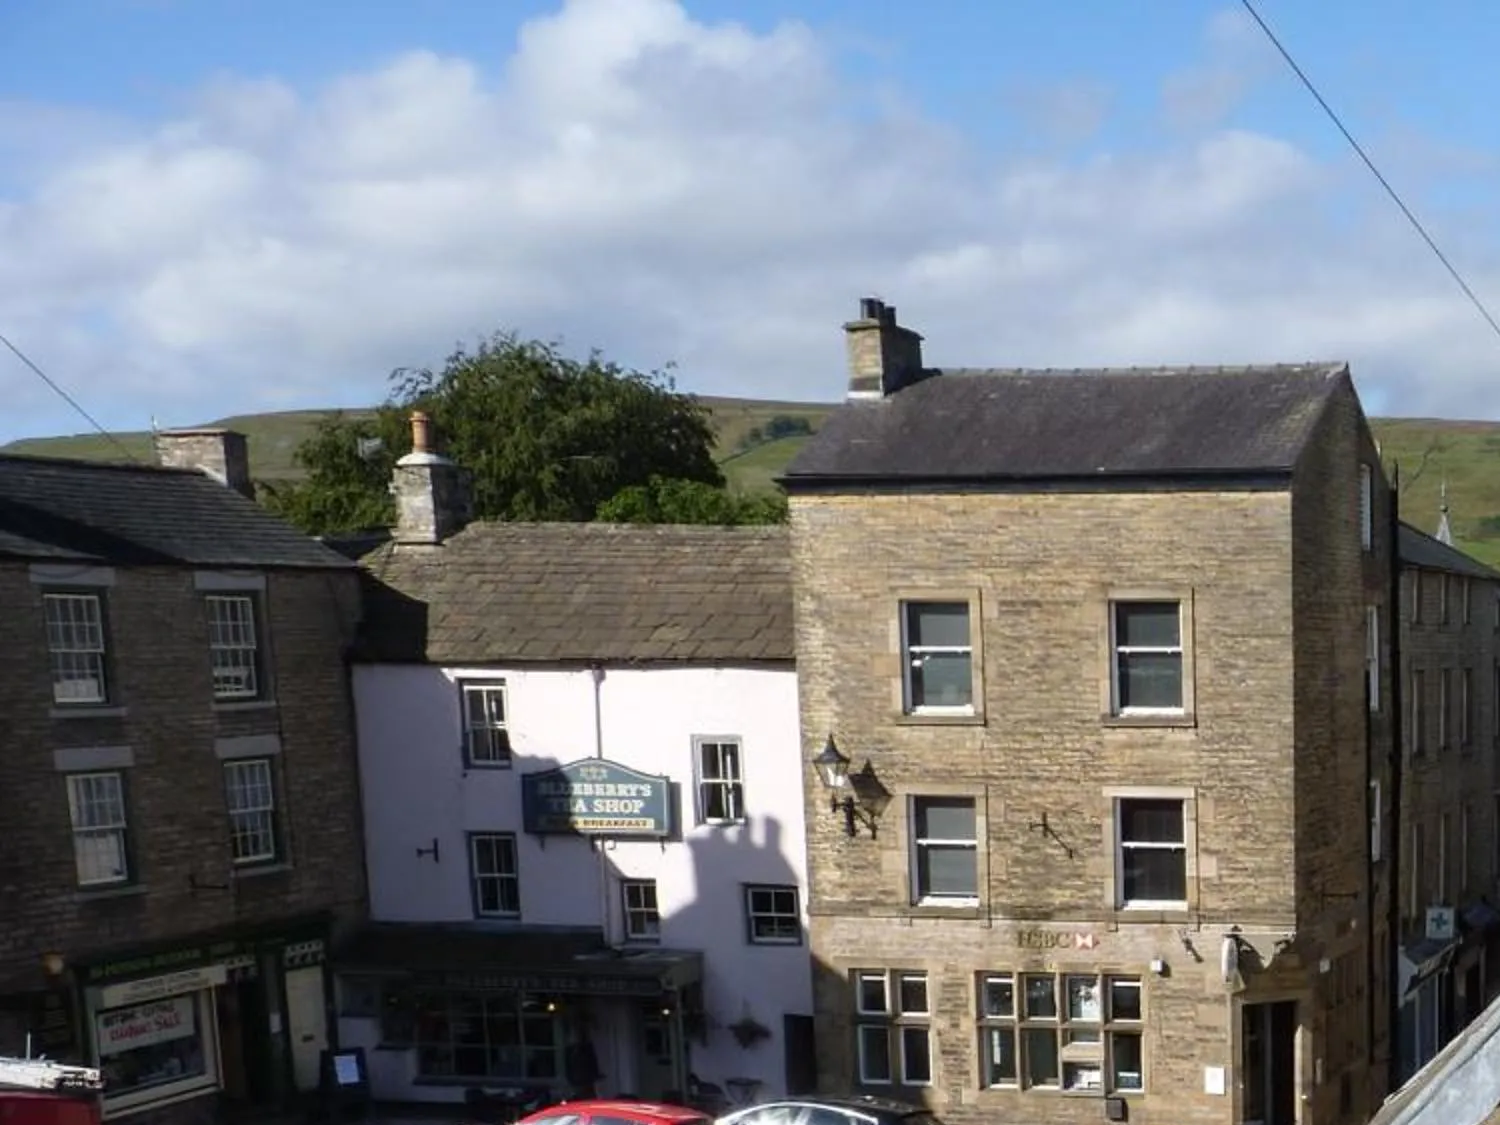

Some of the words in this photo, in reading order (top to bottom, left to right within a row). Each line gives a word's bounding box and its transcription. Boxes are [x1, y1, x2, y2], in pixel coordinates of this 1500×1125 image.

[548, 799, 588, 813] TEA
[593, 799, 645, 814] SHOP
[583, 819, 647, 828] BREAKFAST
[1018, 930, 1071, 949] HSBC
